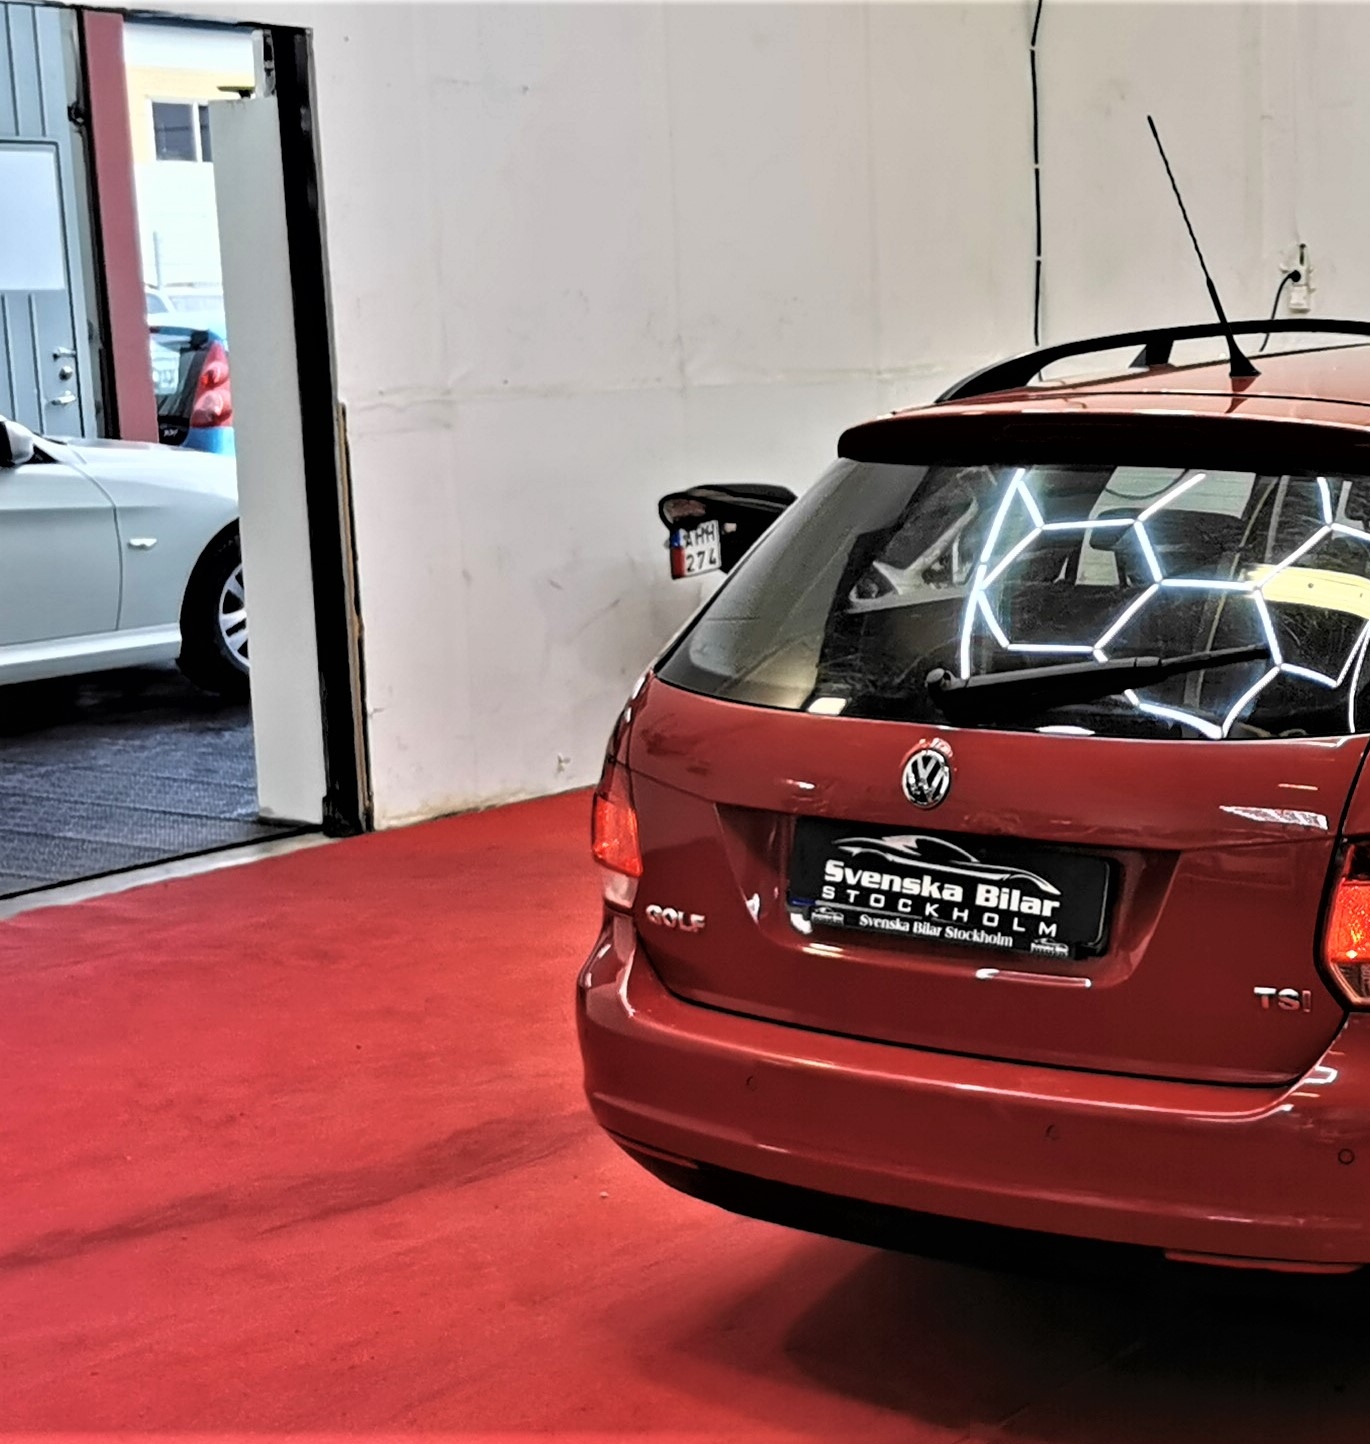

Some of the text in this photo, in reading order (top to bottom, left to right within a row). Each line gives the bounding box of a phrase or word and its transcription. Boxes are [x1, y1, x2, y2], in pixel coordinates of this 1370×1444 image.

[824, 859, 1060, 917] Svenska Bilar
[646, 904, 705, 932] GOLF
[821, 885, 1057, 937] STOCKHOLM
[859, 914, 910, 932] Svenska
[912, 921, 943, 937] Bilar
[944, 926, 1013, 947] Stockholm
[1253, 986, 1312, 1013] TSI
